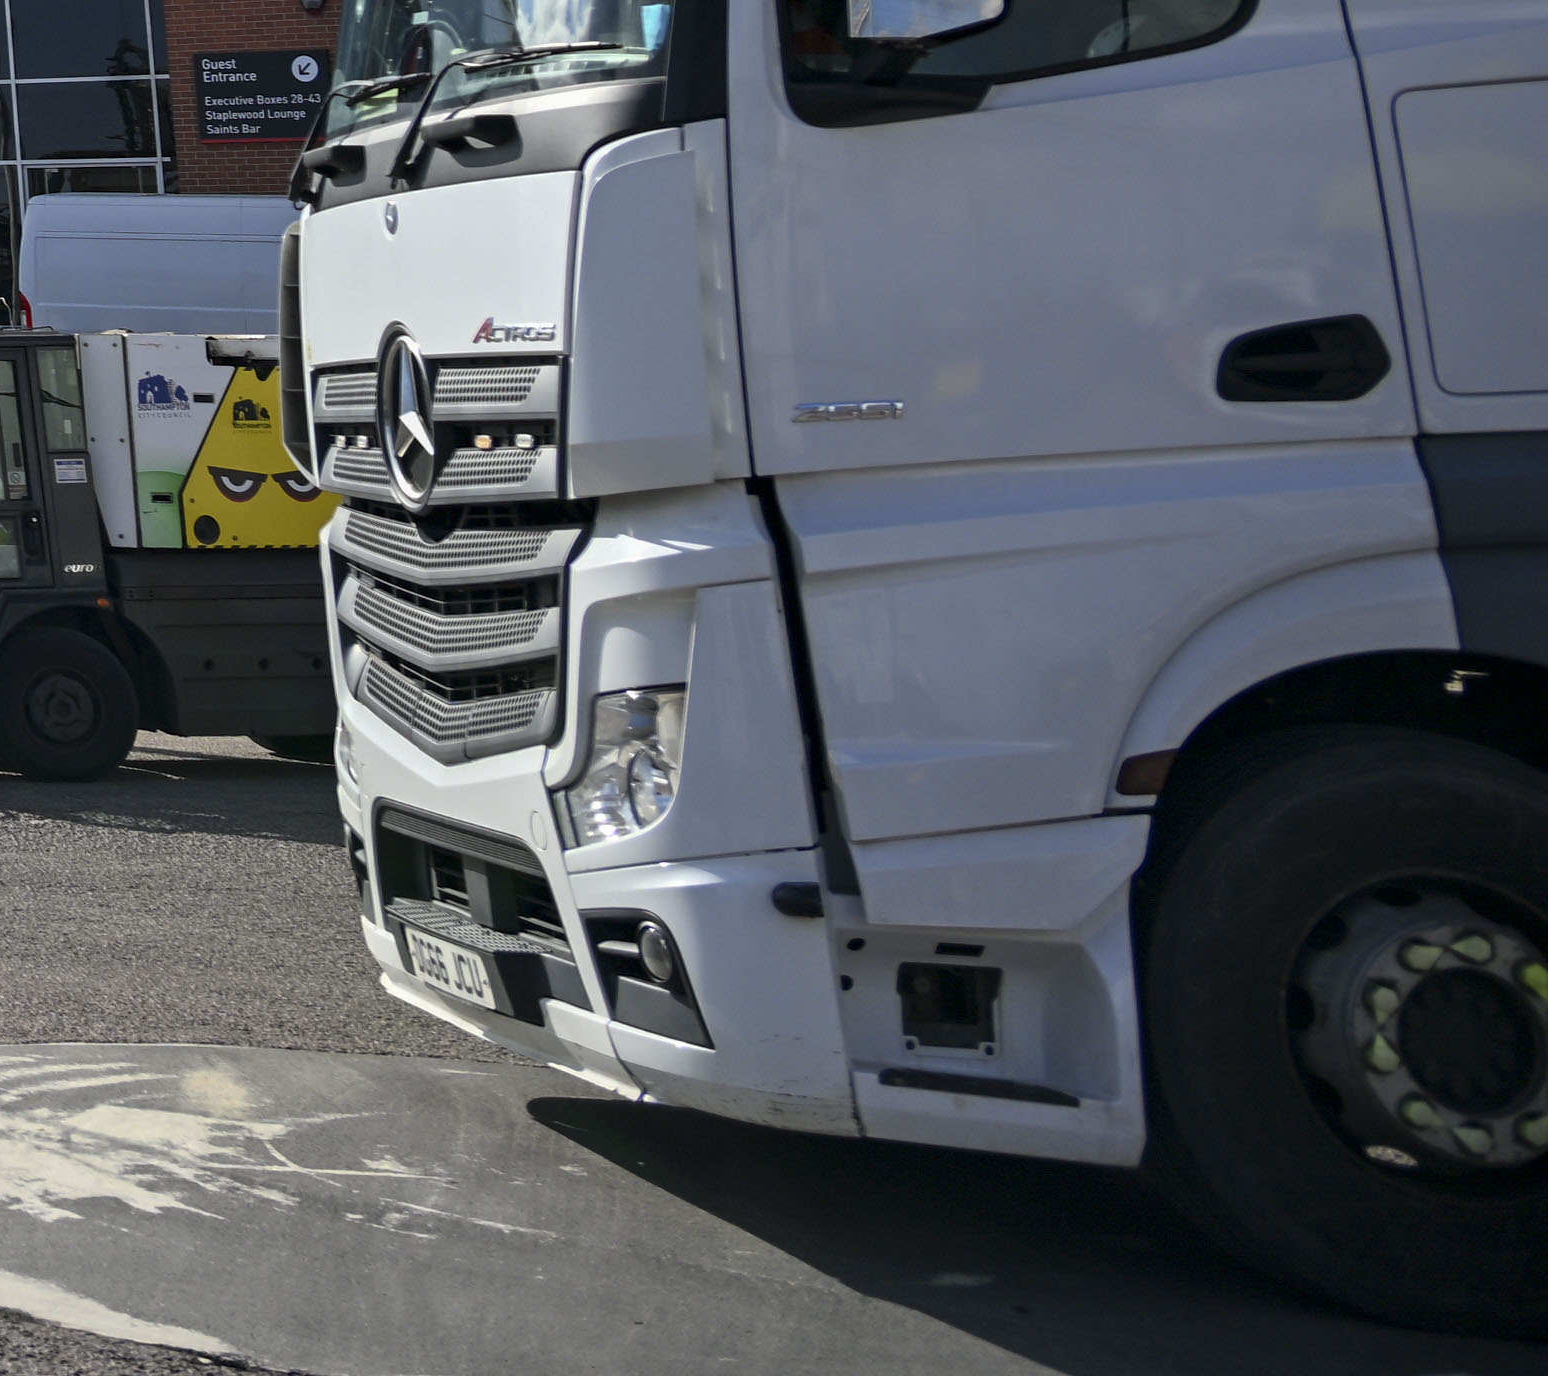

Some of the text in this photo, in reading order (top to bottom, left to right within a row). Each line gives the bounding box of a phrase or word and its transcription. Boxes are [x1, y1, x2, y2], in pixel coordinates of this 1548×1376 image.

[201, 58, 237, 70] Guest
[203, 71, 258, 83] Entrance
[204, 93, 322, 106] Executive Boxes 28-43
[205, 108, 307, 123] Staplewood Lounge
[206, 123, 262, 135] Saints Bar
[137, 403, 190, 411] SOUTHAMPTON
[64, 563, 95, 573] euro
[452, 952, 485, 999] JCU
